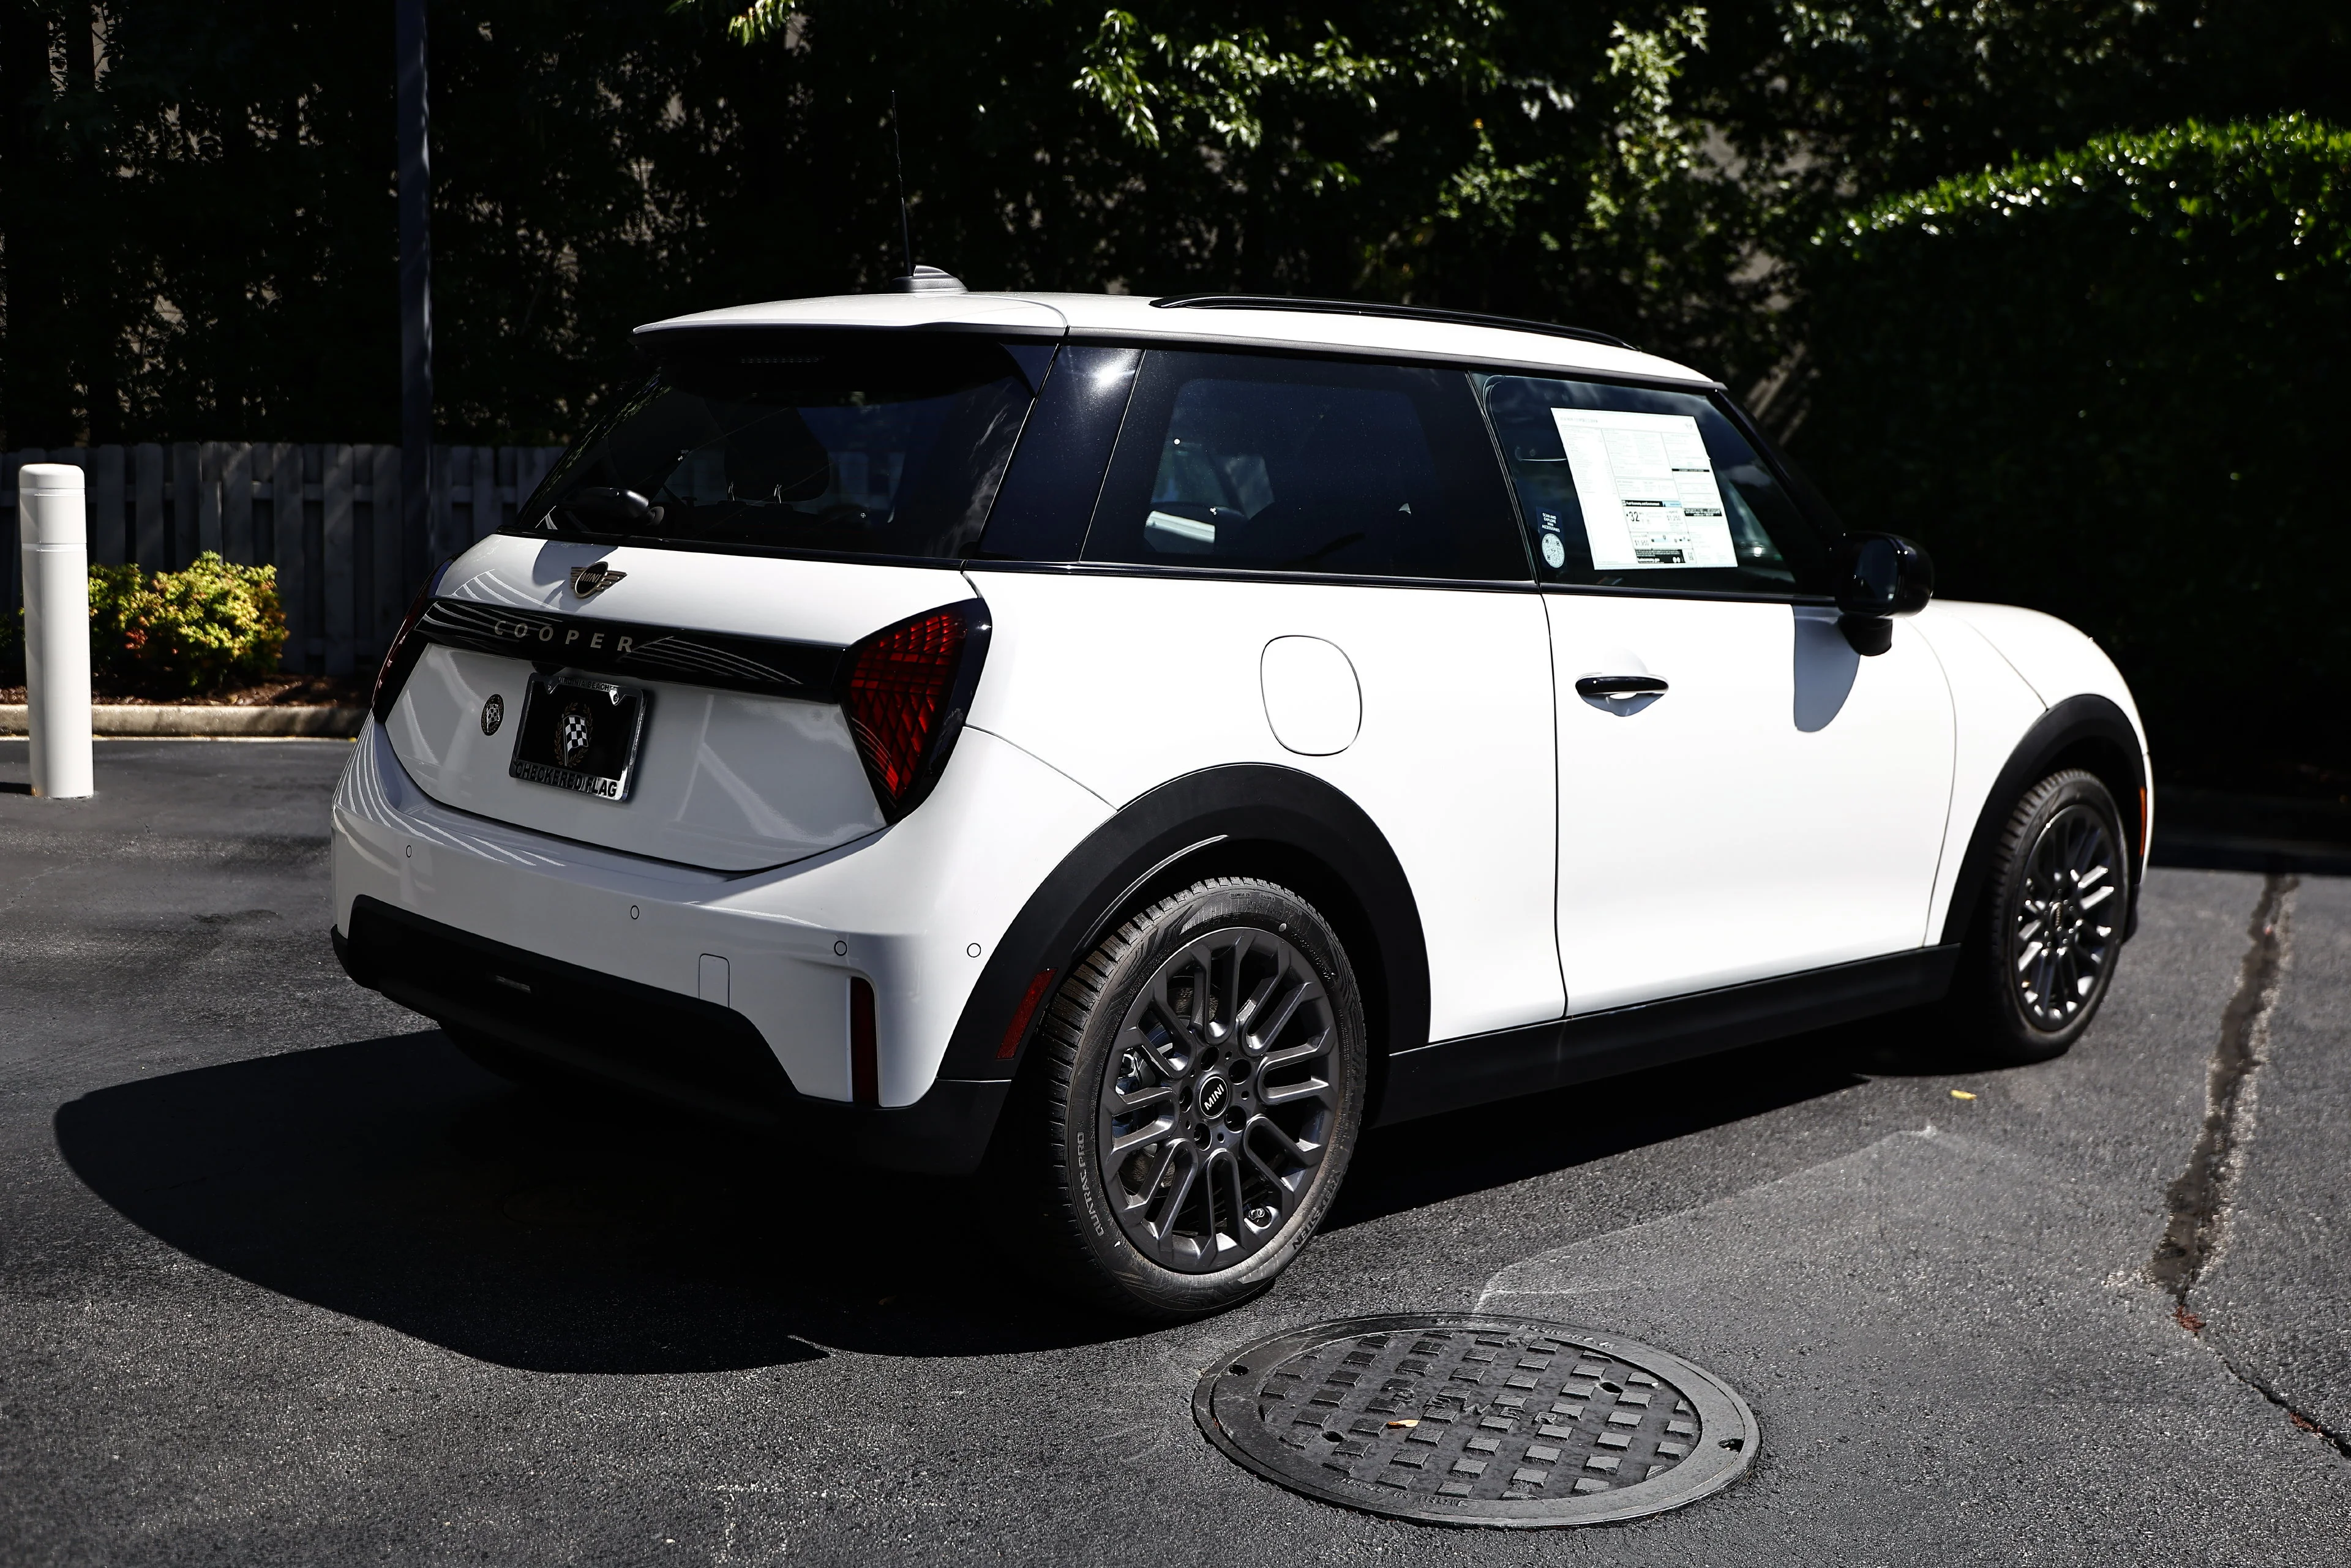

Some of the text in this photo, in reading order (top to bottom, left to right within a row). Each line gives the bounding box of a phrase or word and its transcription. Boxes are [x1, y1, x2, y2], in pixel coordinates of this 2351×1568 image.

[579, 572, 602, 583] MINI
[494, 620, 633, 653] COOPER
[558, 677, 610, 691] VIRGINIA BEACH
[515, 761, 618, 798] CHECKERED FLAG
[1204, 1084, 1224, 1111] MINI
[1077, 1131, 1104, 1237] QUATRAC PRO
[1420, 1495, 1469, 1508] INDIA
